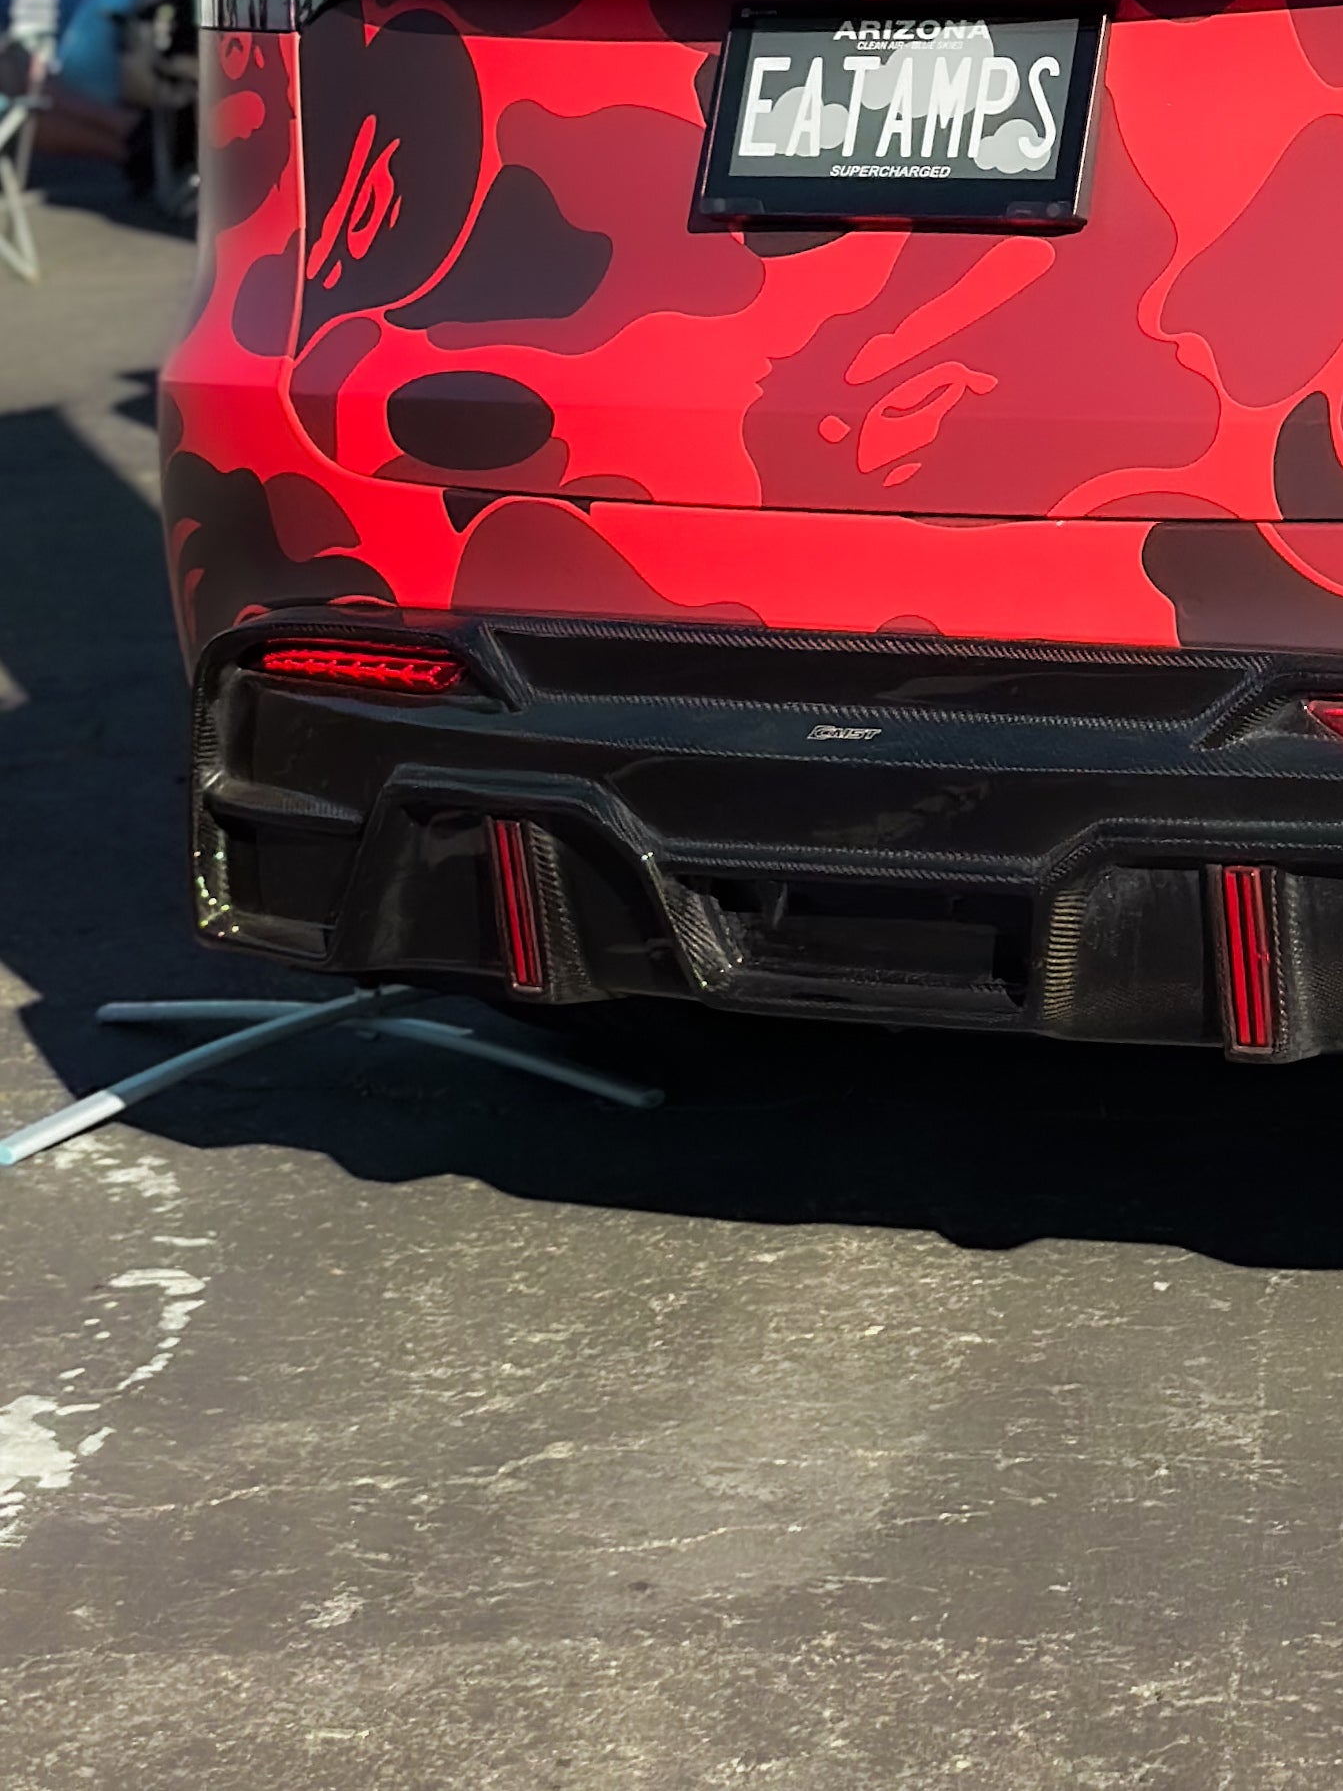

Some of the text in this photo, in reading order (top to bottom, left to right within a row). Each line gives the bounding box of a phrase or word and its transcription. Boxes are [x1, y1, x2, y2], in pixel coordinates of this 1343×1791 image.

[833, 20, 990, 40] ARIZONA
[738, 56, 1060, 159] EATAMPS
[830, 165, 951, 178] SUPERCHARGED
